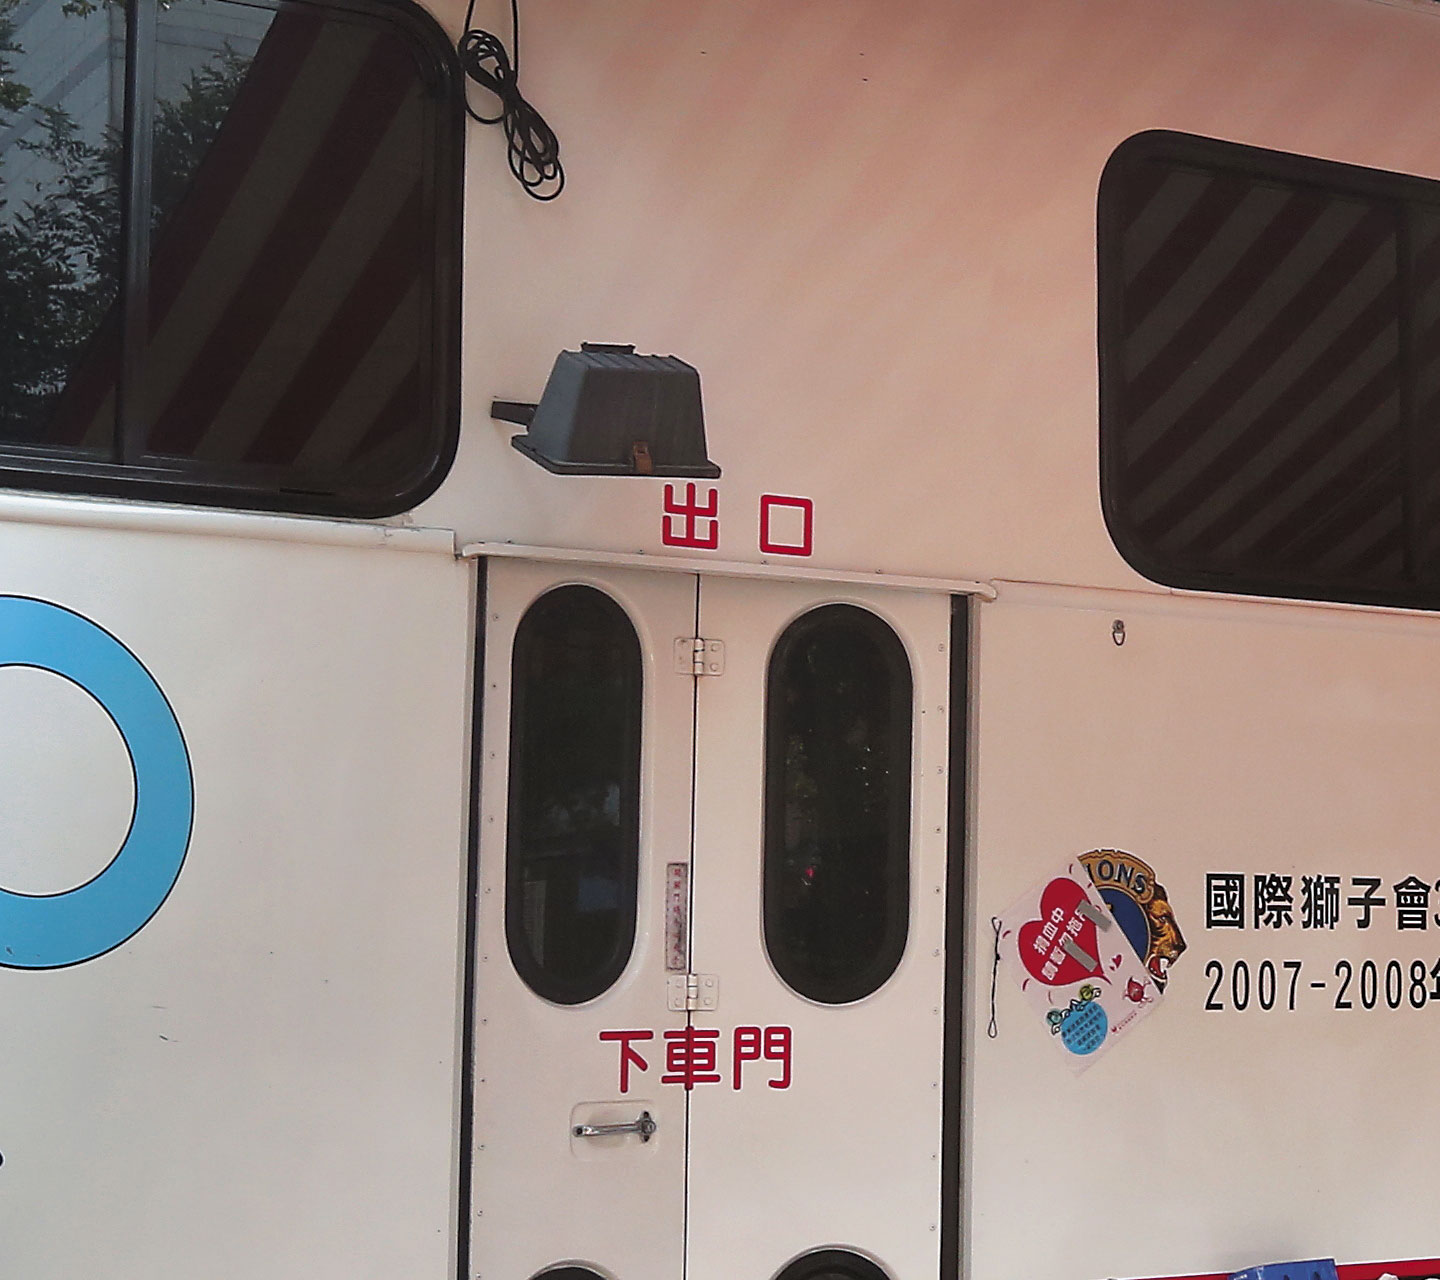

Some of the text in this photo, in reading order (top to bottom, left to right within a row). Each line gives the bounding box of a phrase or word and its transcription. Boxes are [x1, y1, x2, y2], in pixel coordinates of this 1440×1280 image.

[661, 482, 814, 558] 出口
[599, 1023, 794, 1094] 下車門
